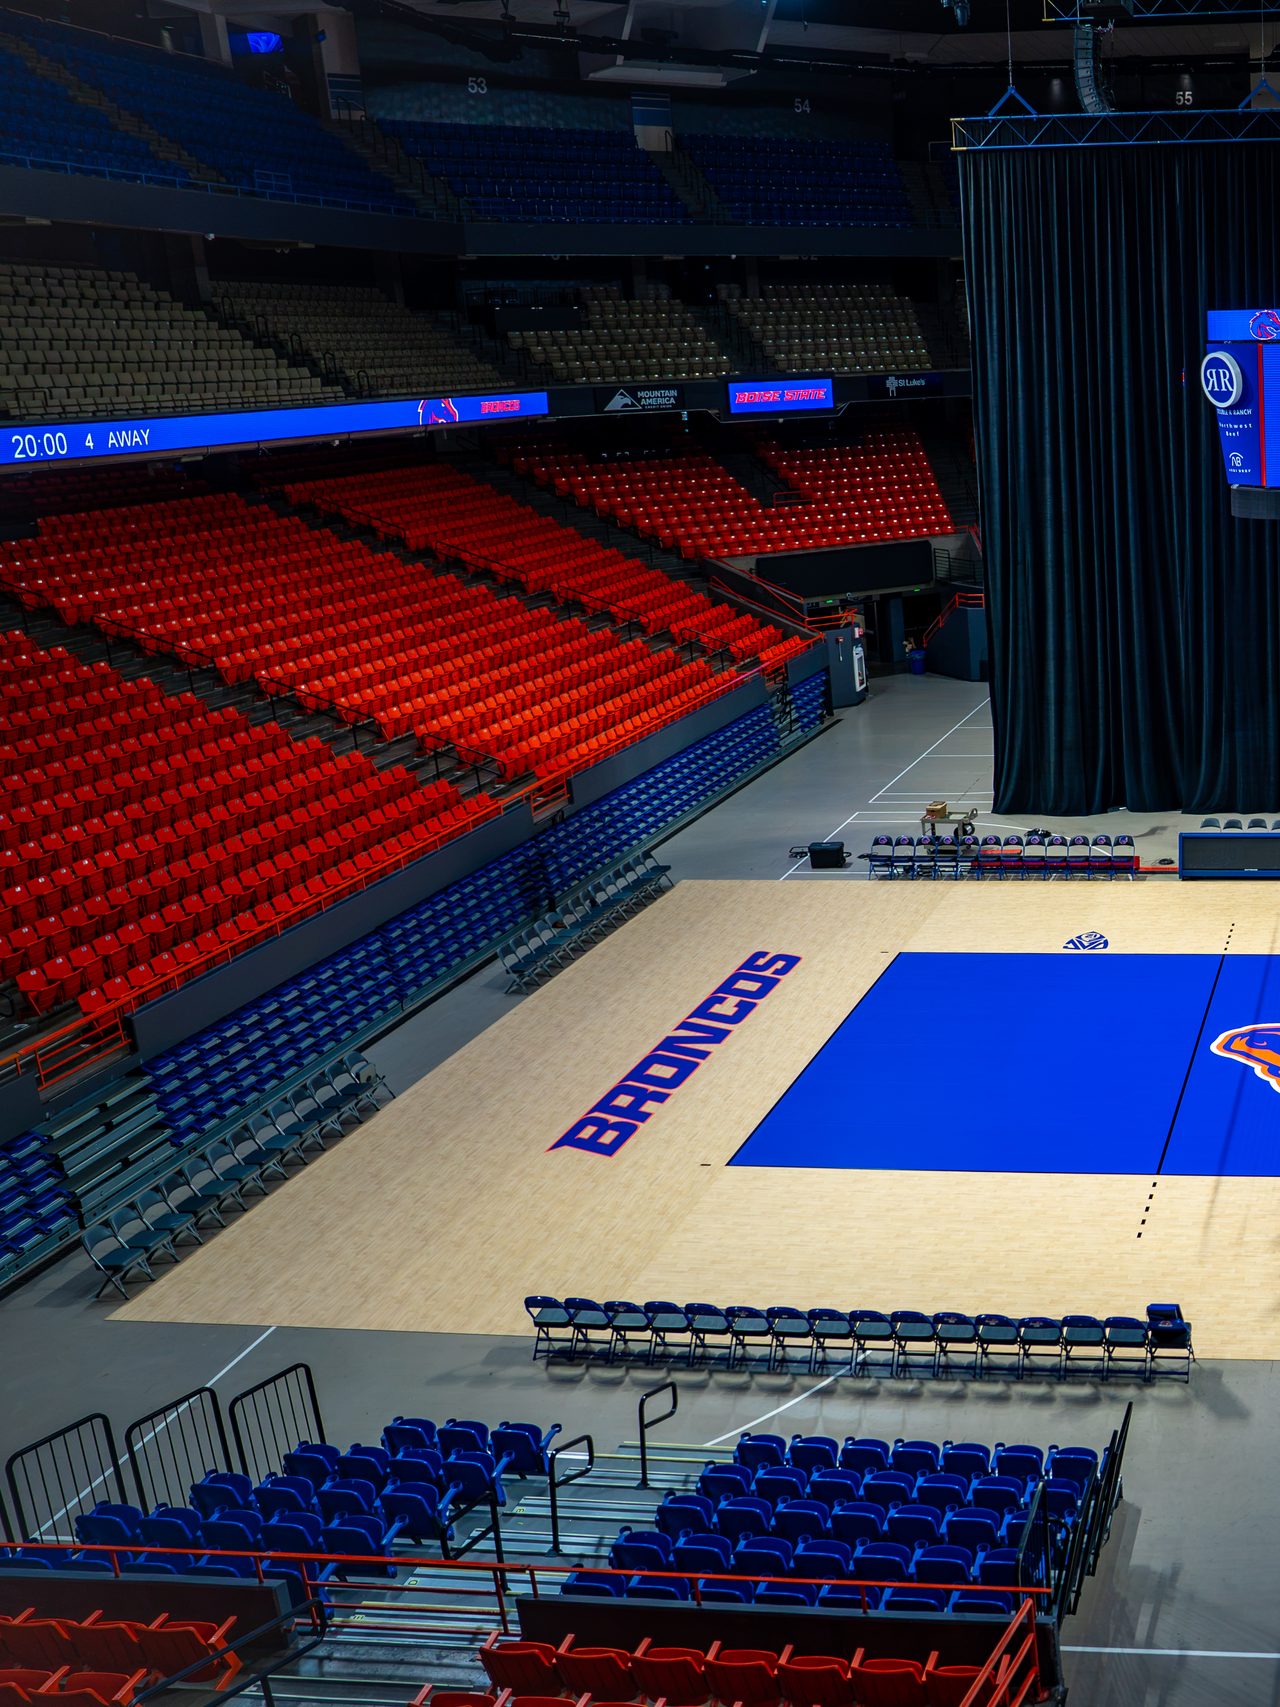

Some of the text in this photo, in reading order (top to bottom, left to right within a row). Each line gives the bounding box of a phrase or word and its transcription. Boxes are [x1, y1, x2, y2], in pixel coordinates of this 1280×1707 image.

[467, 76, 488, 94] 53
[793, 97, 811, 114] 54
[1175, 90, 1193, 106] 55
[637, 389, 678, 398] MOUNTAIN
[641, 397, 676, 405] AMERICA
[735, 388, 827, 403] BOISE STATE
[11, 428, 150, 458] 20:00 4 AWAY
[545, 950, 802, 1157] BRONCOS
